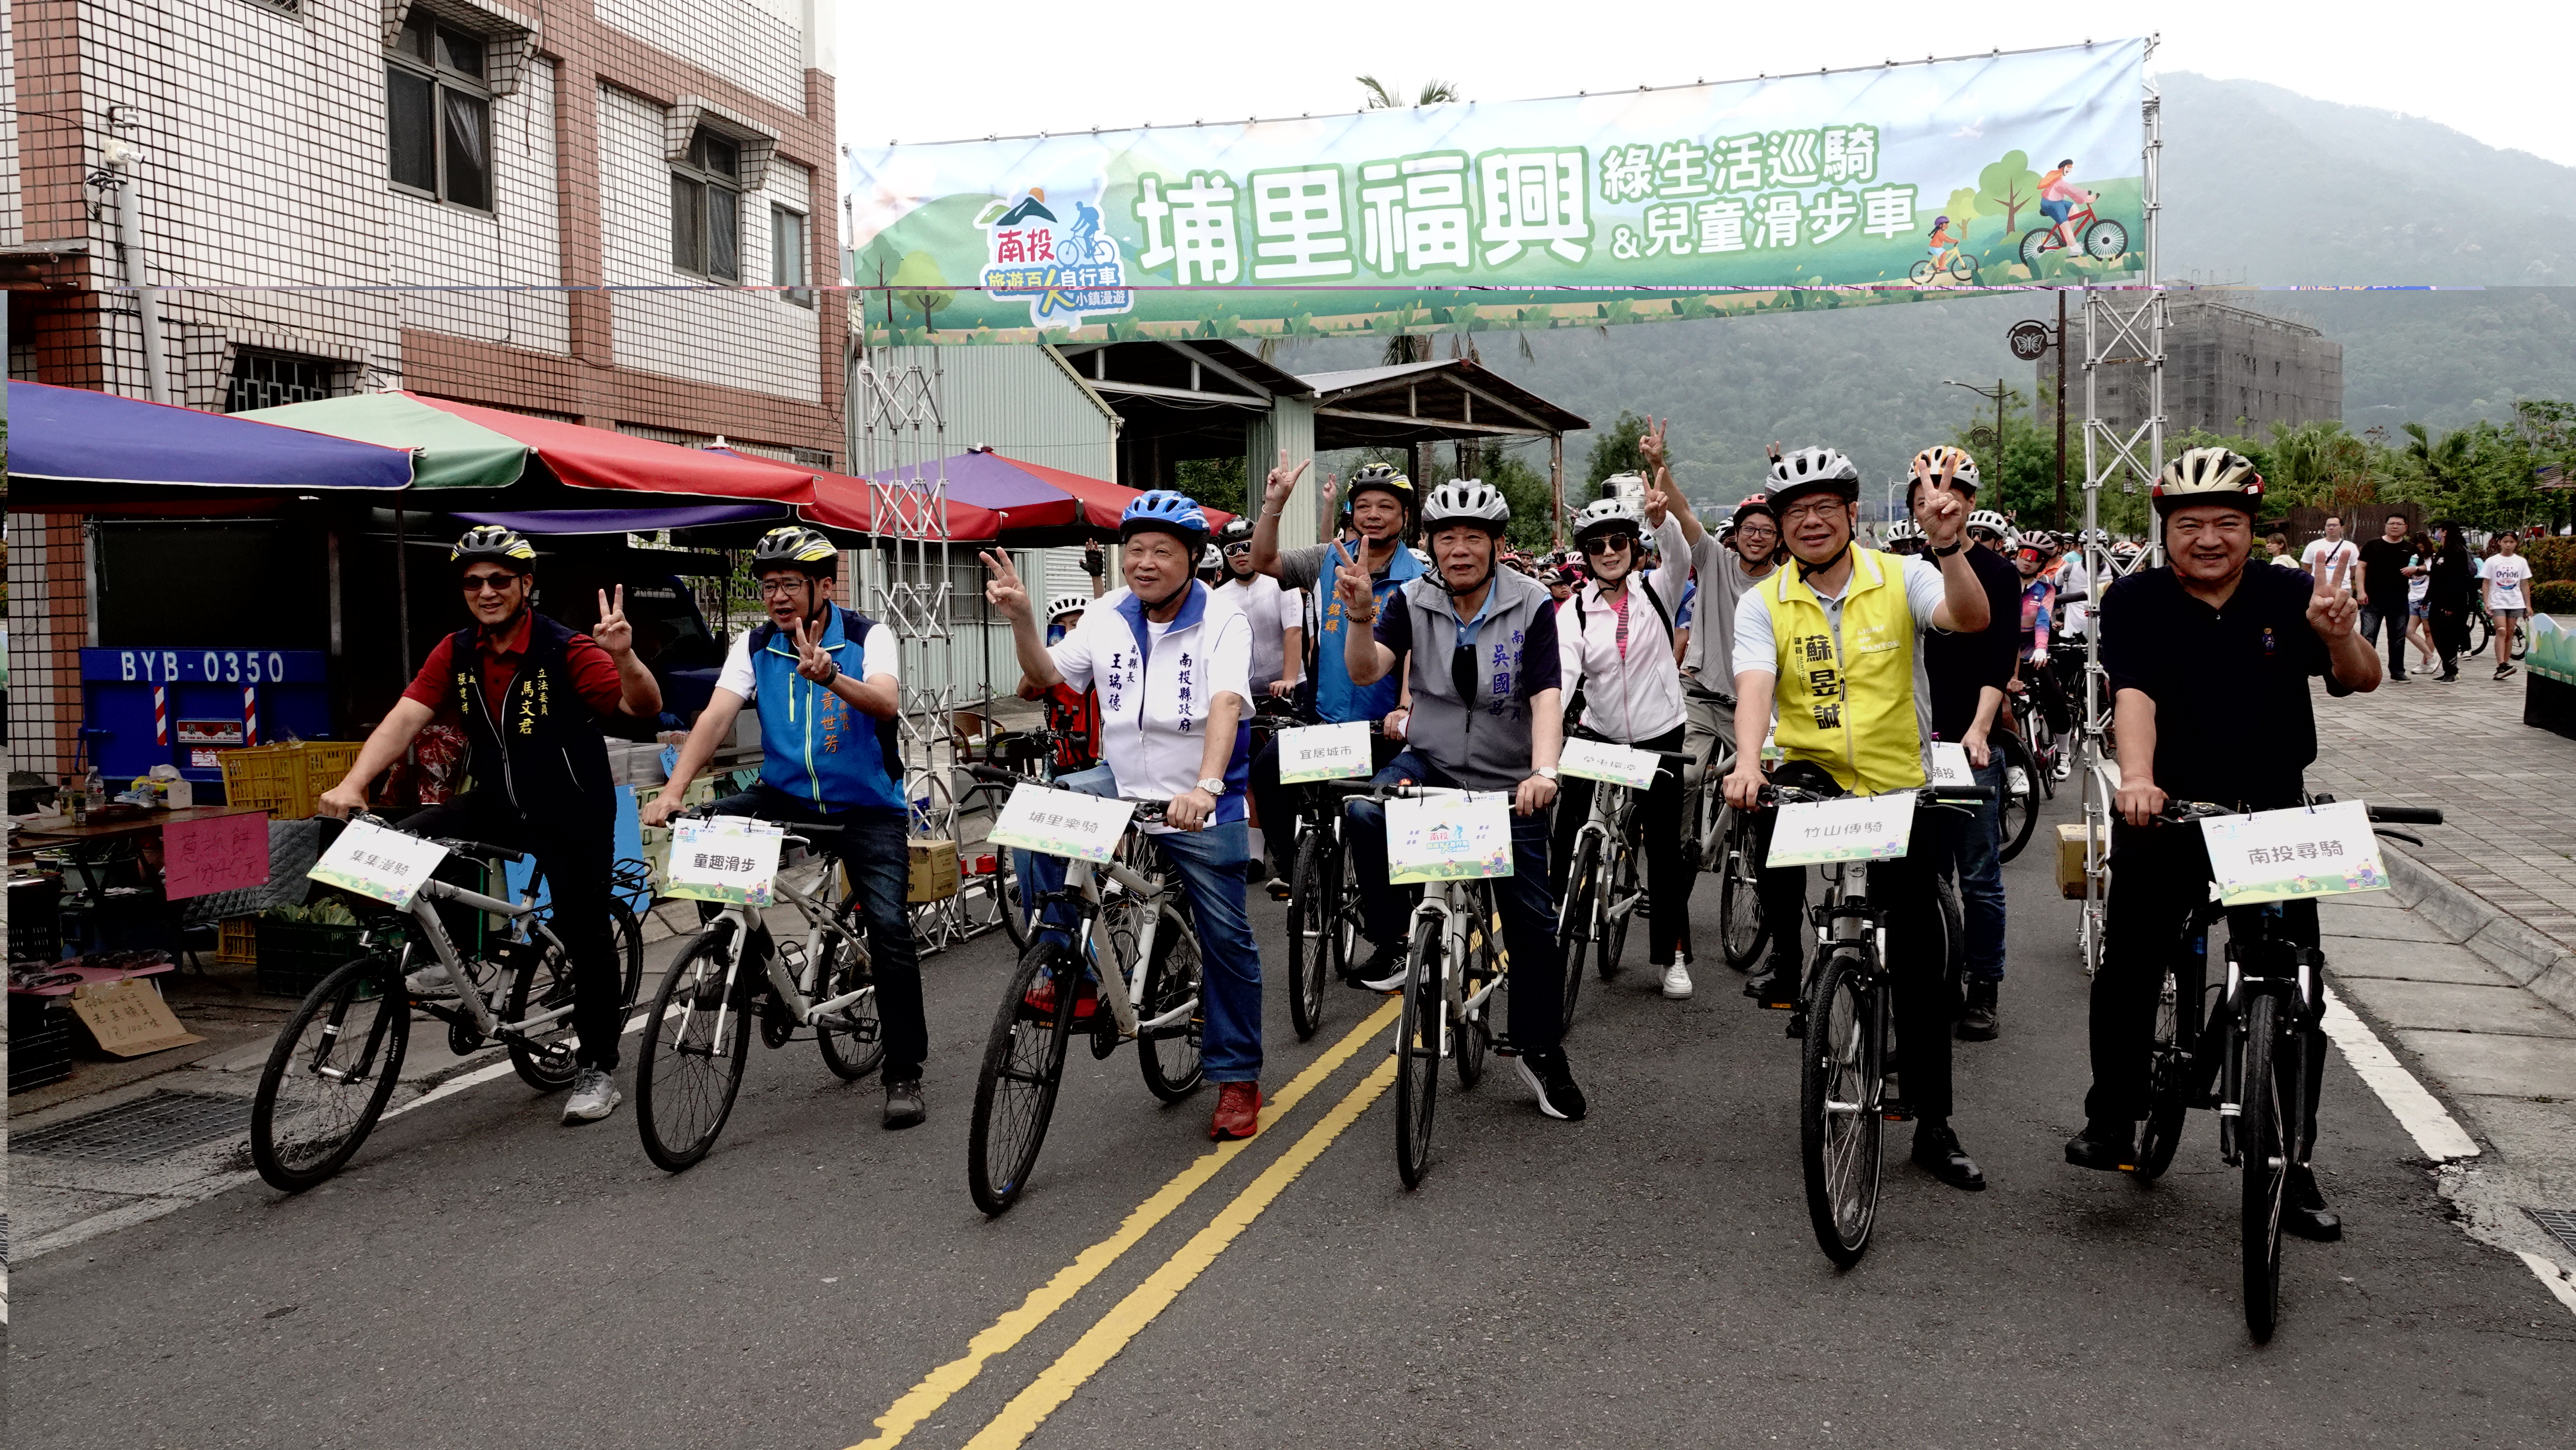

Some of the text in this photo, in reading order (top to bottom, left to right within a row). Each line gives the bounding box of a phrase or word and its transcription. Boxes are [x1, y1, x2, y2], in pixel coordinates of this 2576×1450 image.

[1602, 127, 1875, 200] 綠生活巡騎
[1137, 152, 1588, 284] 埔里福興
[1612, 187, 1916, 259] &兒童滑步車
[998, 228, 1055, 263] 南投
[1076, 290, 1125, 306] 小鎮漫遊
[2496, 569, 2519, 578] Orion
[1858, 625, 1884, 635] LIGHT
[1860, 640, 1900, 651] NANTOU
[121, 652, 283, 682] BYB-0350
[1127, 645, 1138, 682] 副縣長
[537, 668, 548, 716] 立法委員
[1109, 653, 1122, 711] 王瑞德
[1178, 652, 1193, 731] 南投縣政府
[1488, 644, 1510, 716] 吳國昌
[1805, 635, 1841, 729] 蘇昱誠
[518, 681, 536, 734] 馬文君
[821, 692, 839, 753] 黃世芳
[1300, 746, 1352, 759] 宜居城市
[1028, 811, 1099, 833] 埔里樂騎
[1430, 832, 1449, 841] 南投
[1804, 822, 1883, 838] 竹山傳騎
[349, 850, 411, 876] 集集漫騎
[693, 853, 755, 872] 童趣滑步
[2247, 839, 2344, 865] 南投尋騎
